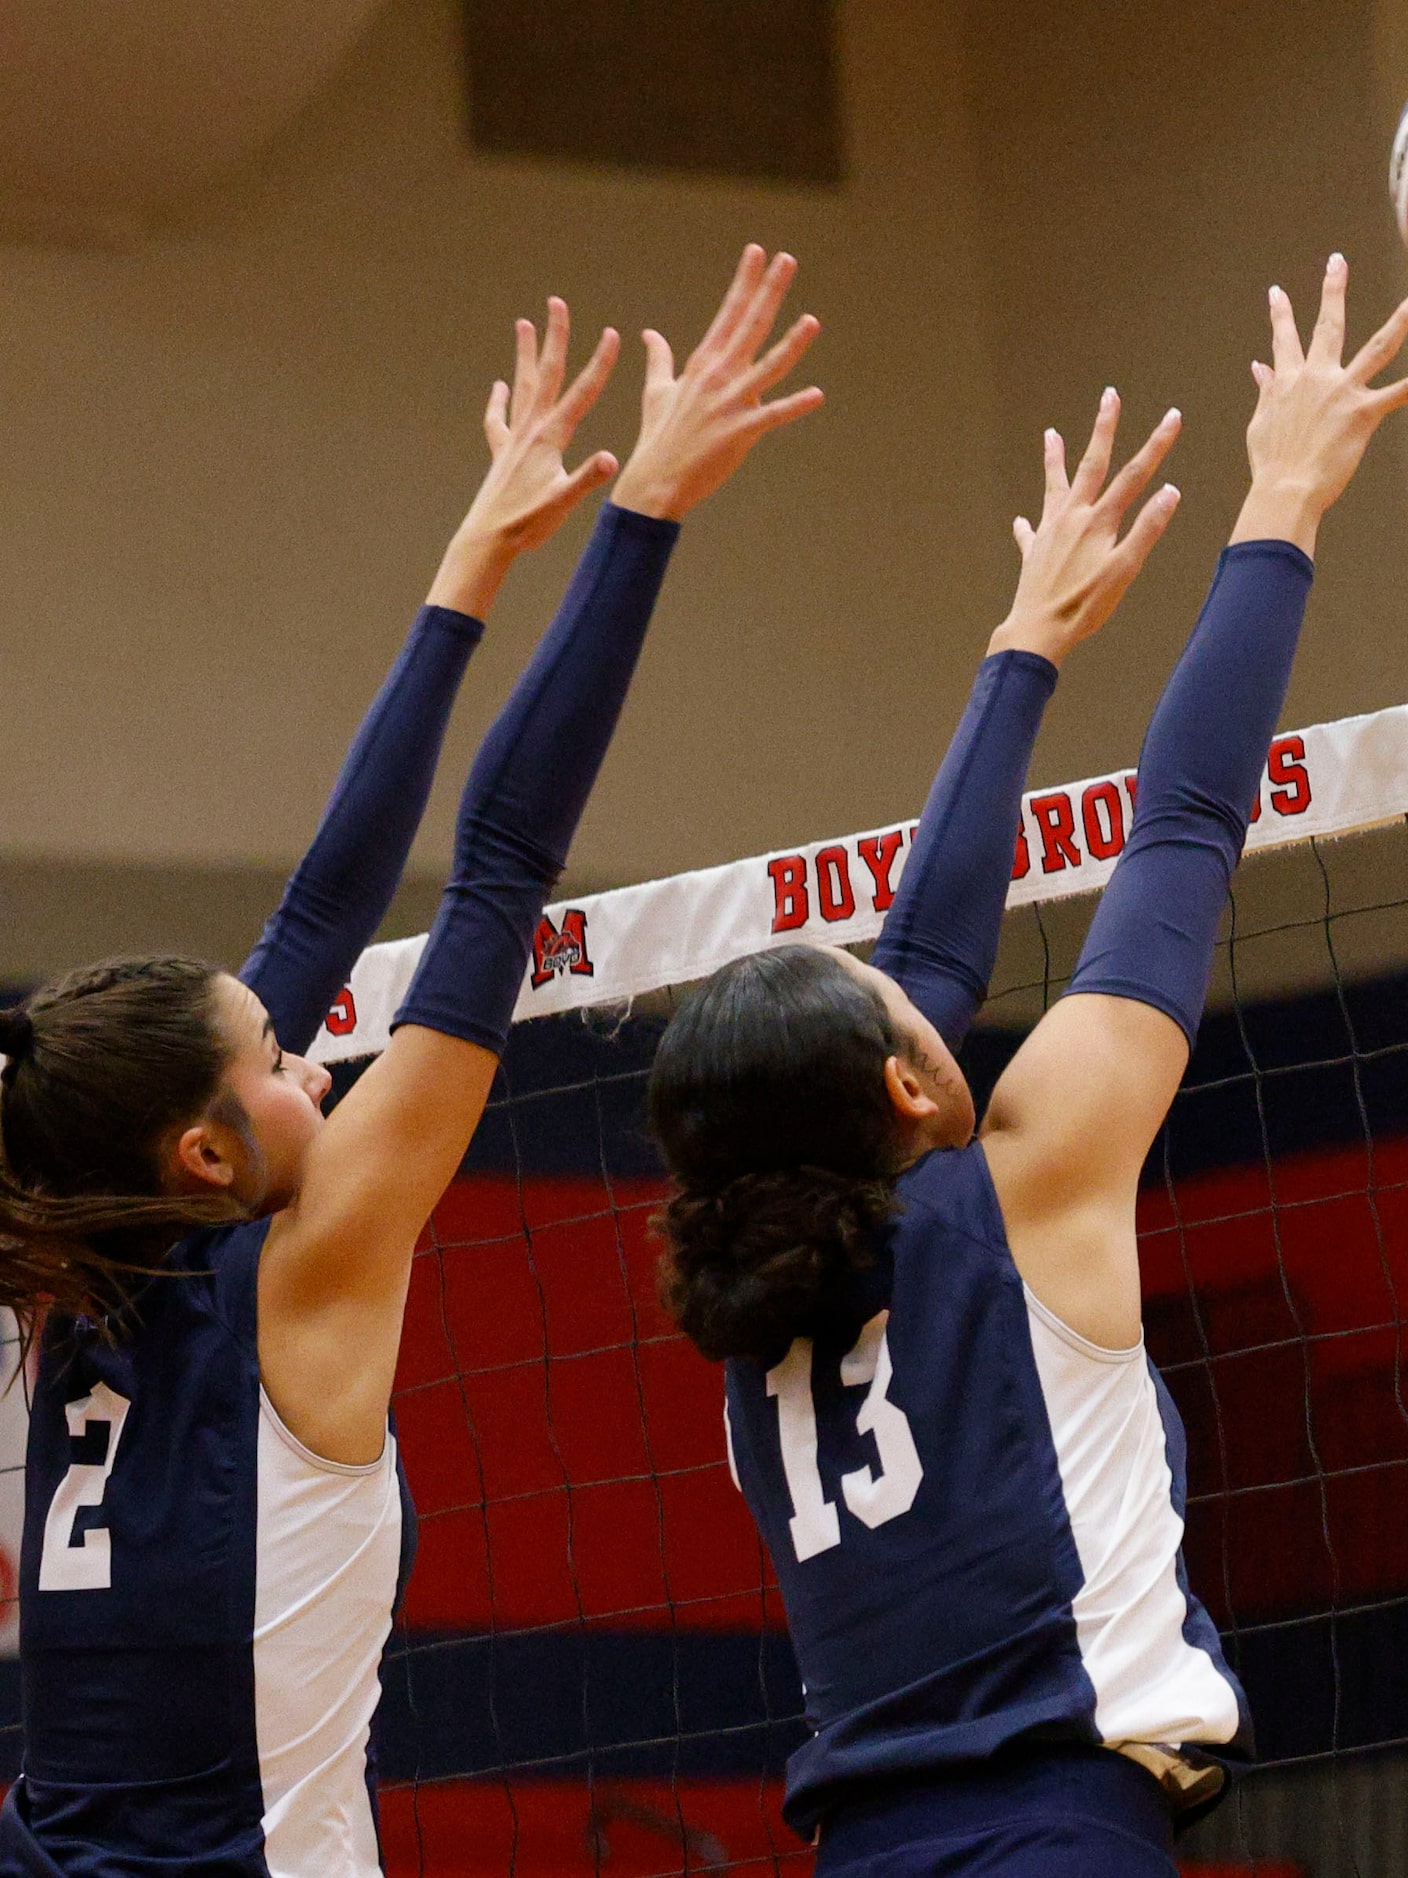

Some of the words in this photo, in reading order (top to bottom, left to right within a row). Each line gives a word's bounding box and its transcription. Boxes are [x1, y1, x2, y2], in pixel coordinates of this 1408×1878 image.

[768, 826, 919, 933] BOY
[38, 1381, 131, 1591] 2
[766, 1309, 924, 1563] 13
